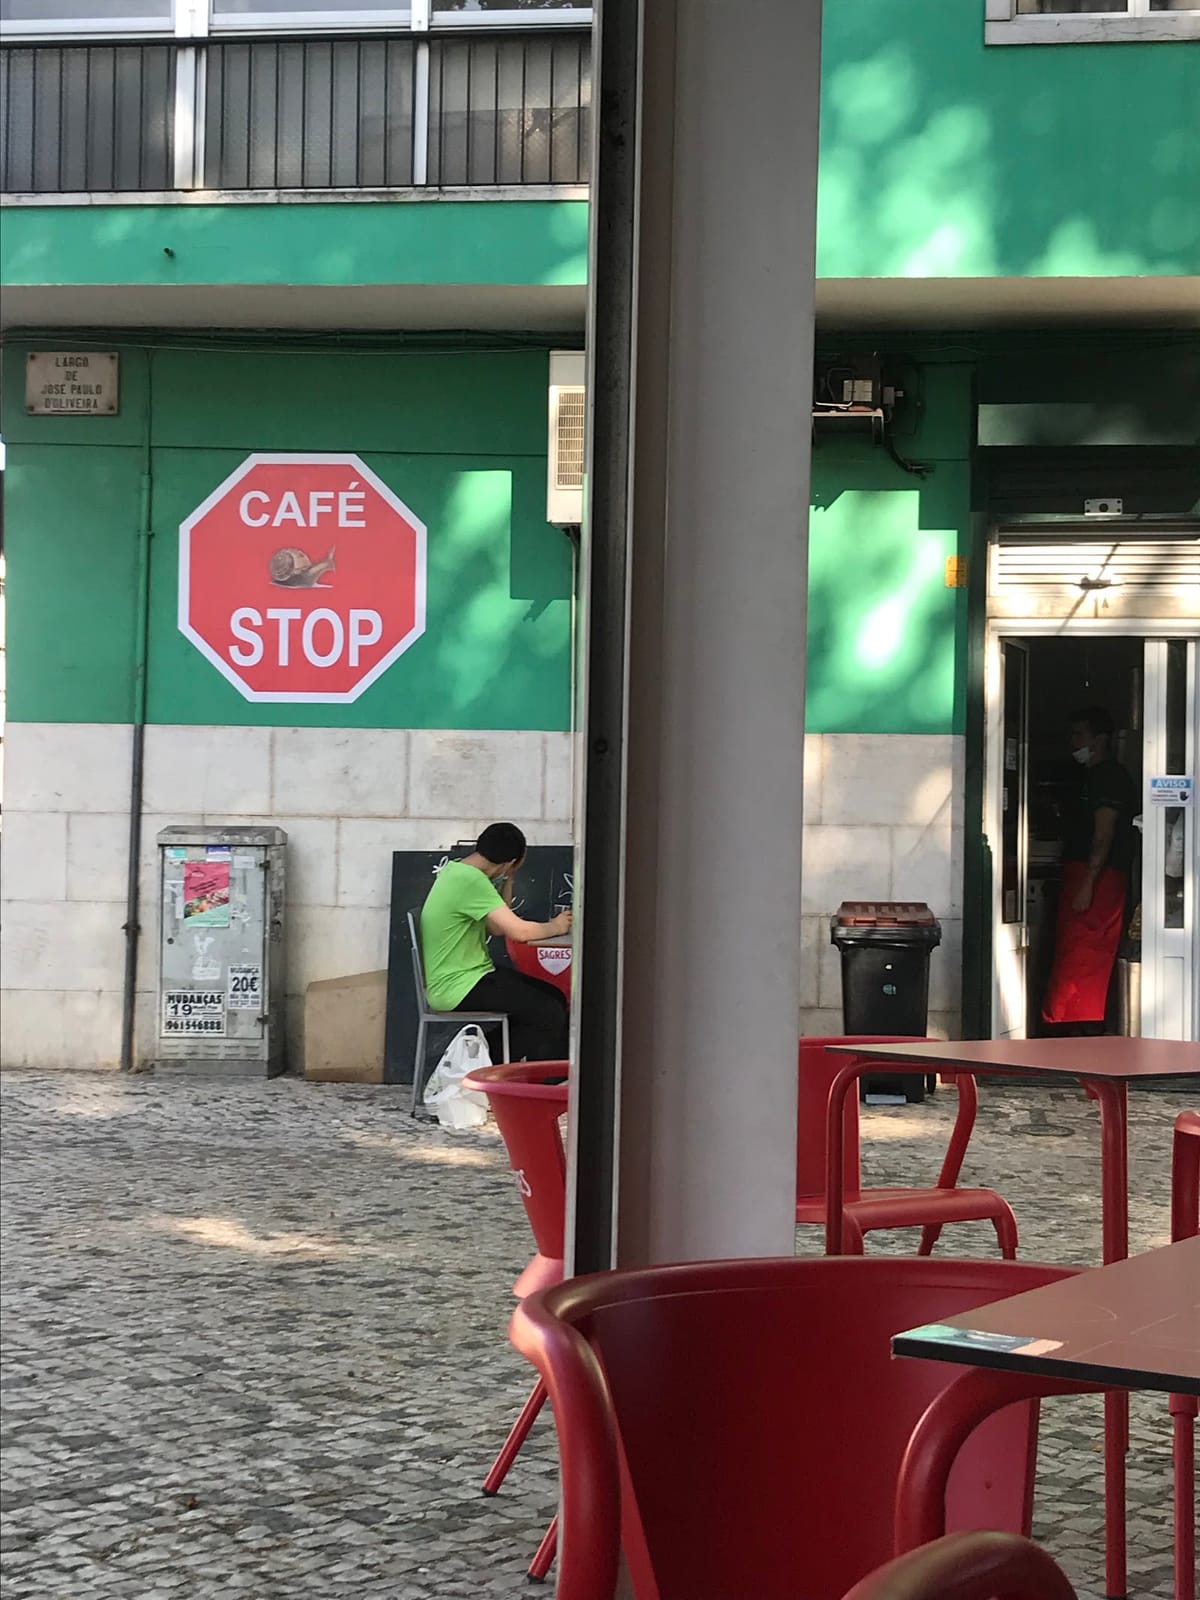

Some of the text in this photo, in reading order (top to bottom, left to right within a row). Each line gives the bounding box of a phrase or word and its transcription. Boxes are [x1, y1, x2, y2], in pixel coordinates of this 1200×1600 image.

[55, 357, 89, 368] LARGO
[64, 370, 79, 381] DE
[71, 384, 103, 395] PAULO
[239, 482, 366, 528] CAFÉ
[228, 607, 383, 667] STOP
[1155, 779, 1187, 788] AVISO
[539, 949, 571, 960] SAGRES
[231, 976, 258, 992] 20€
[167, 994, 222, 1005] MUDANÇAS
